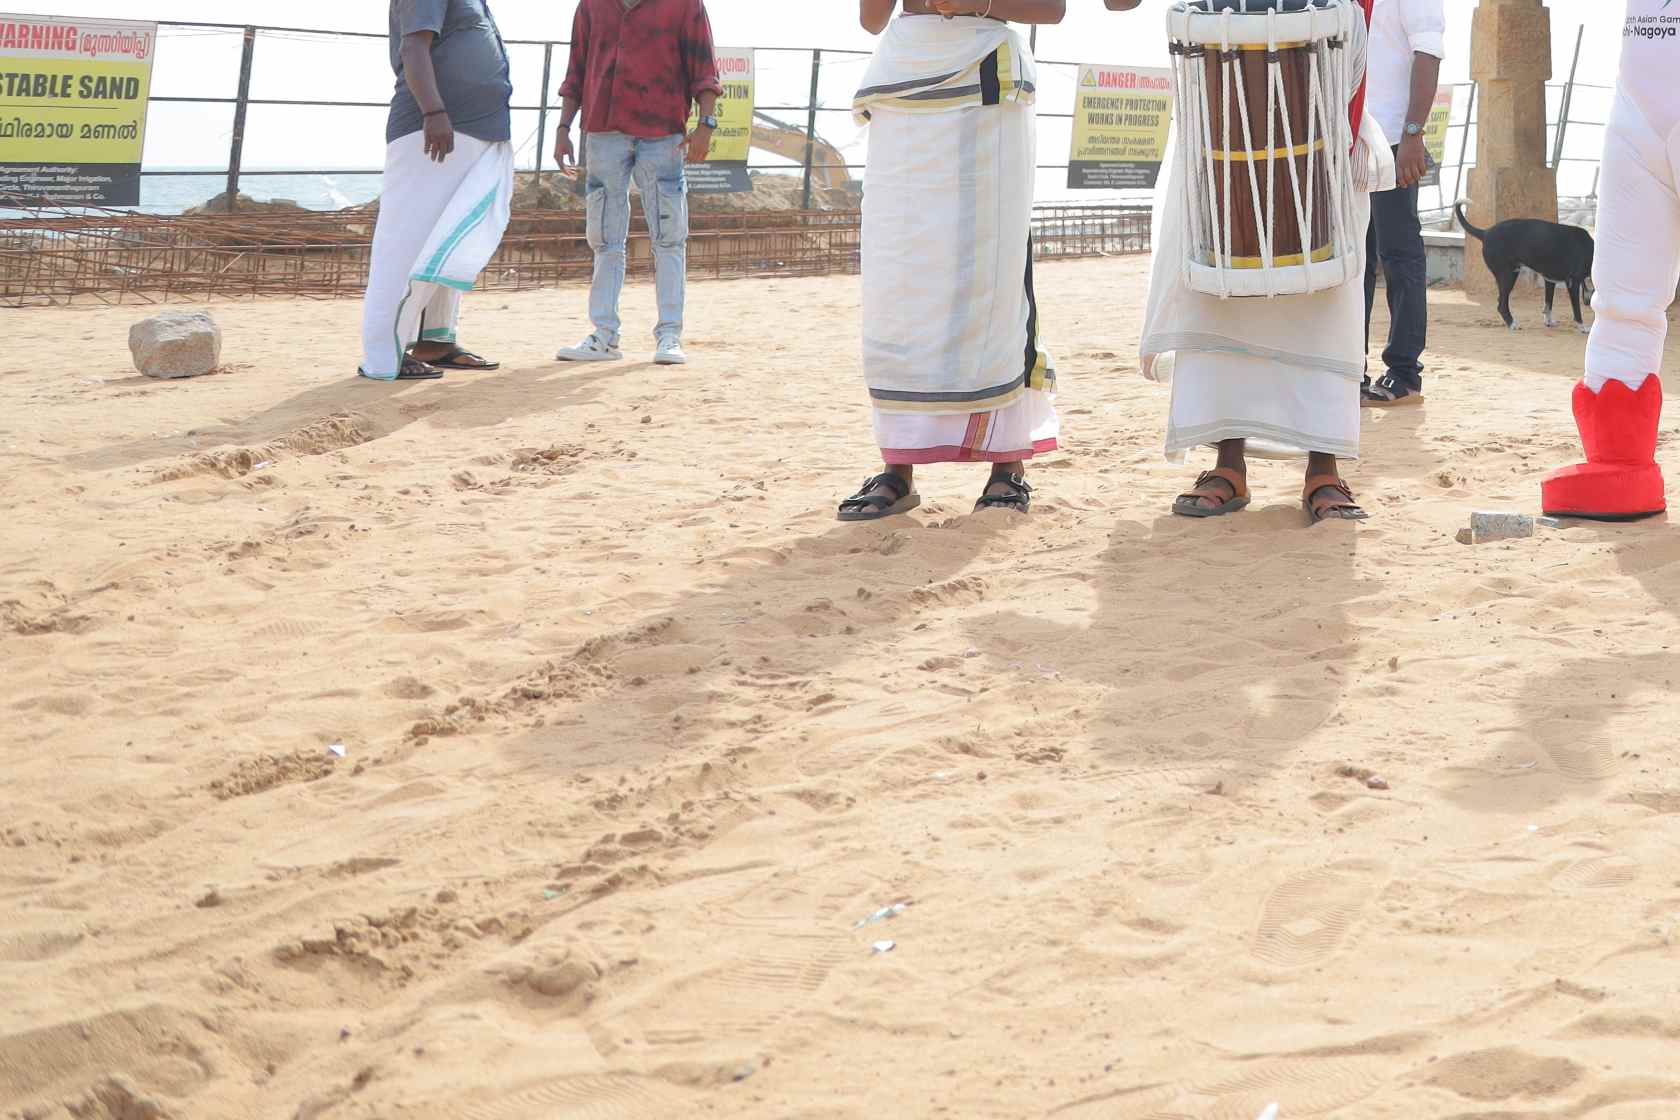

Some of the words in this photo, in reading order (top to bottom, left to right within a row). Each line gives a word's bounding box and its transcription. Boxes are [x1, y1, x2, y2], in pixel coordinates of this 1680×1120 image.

[1637, 16, 1658, 24] Asian
[78, 75, 140, 100] SAND
[1098, 71, 1136, 89] DANGER
[1082, 96, 1123, 110] EMERGENCY
[1124, 97, 1167, 112] PROTECTION
[1088, 113, 1114, 125] WORKS
[1115, 113, 1123, 126] IN
[1124, 114, 1160, 127] PROGRESS
